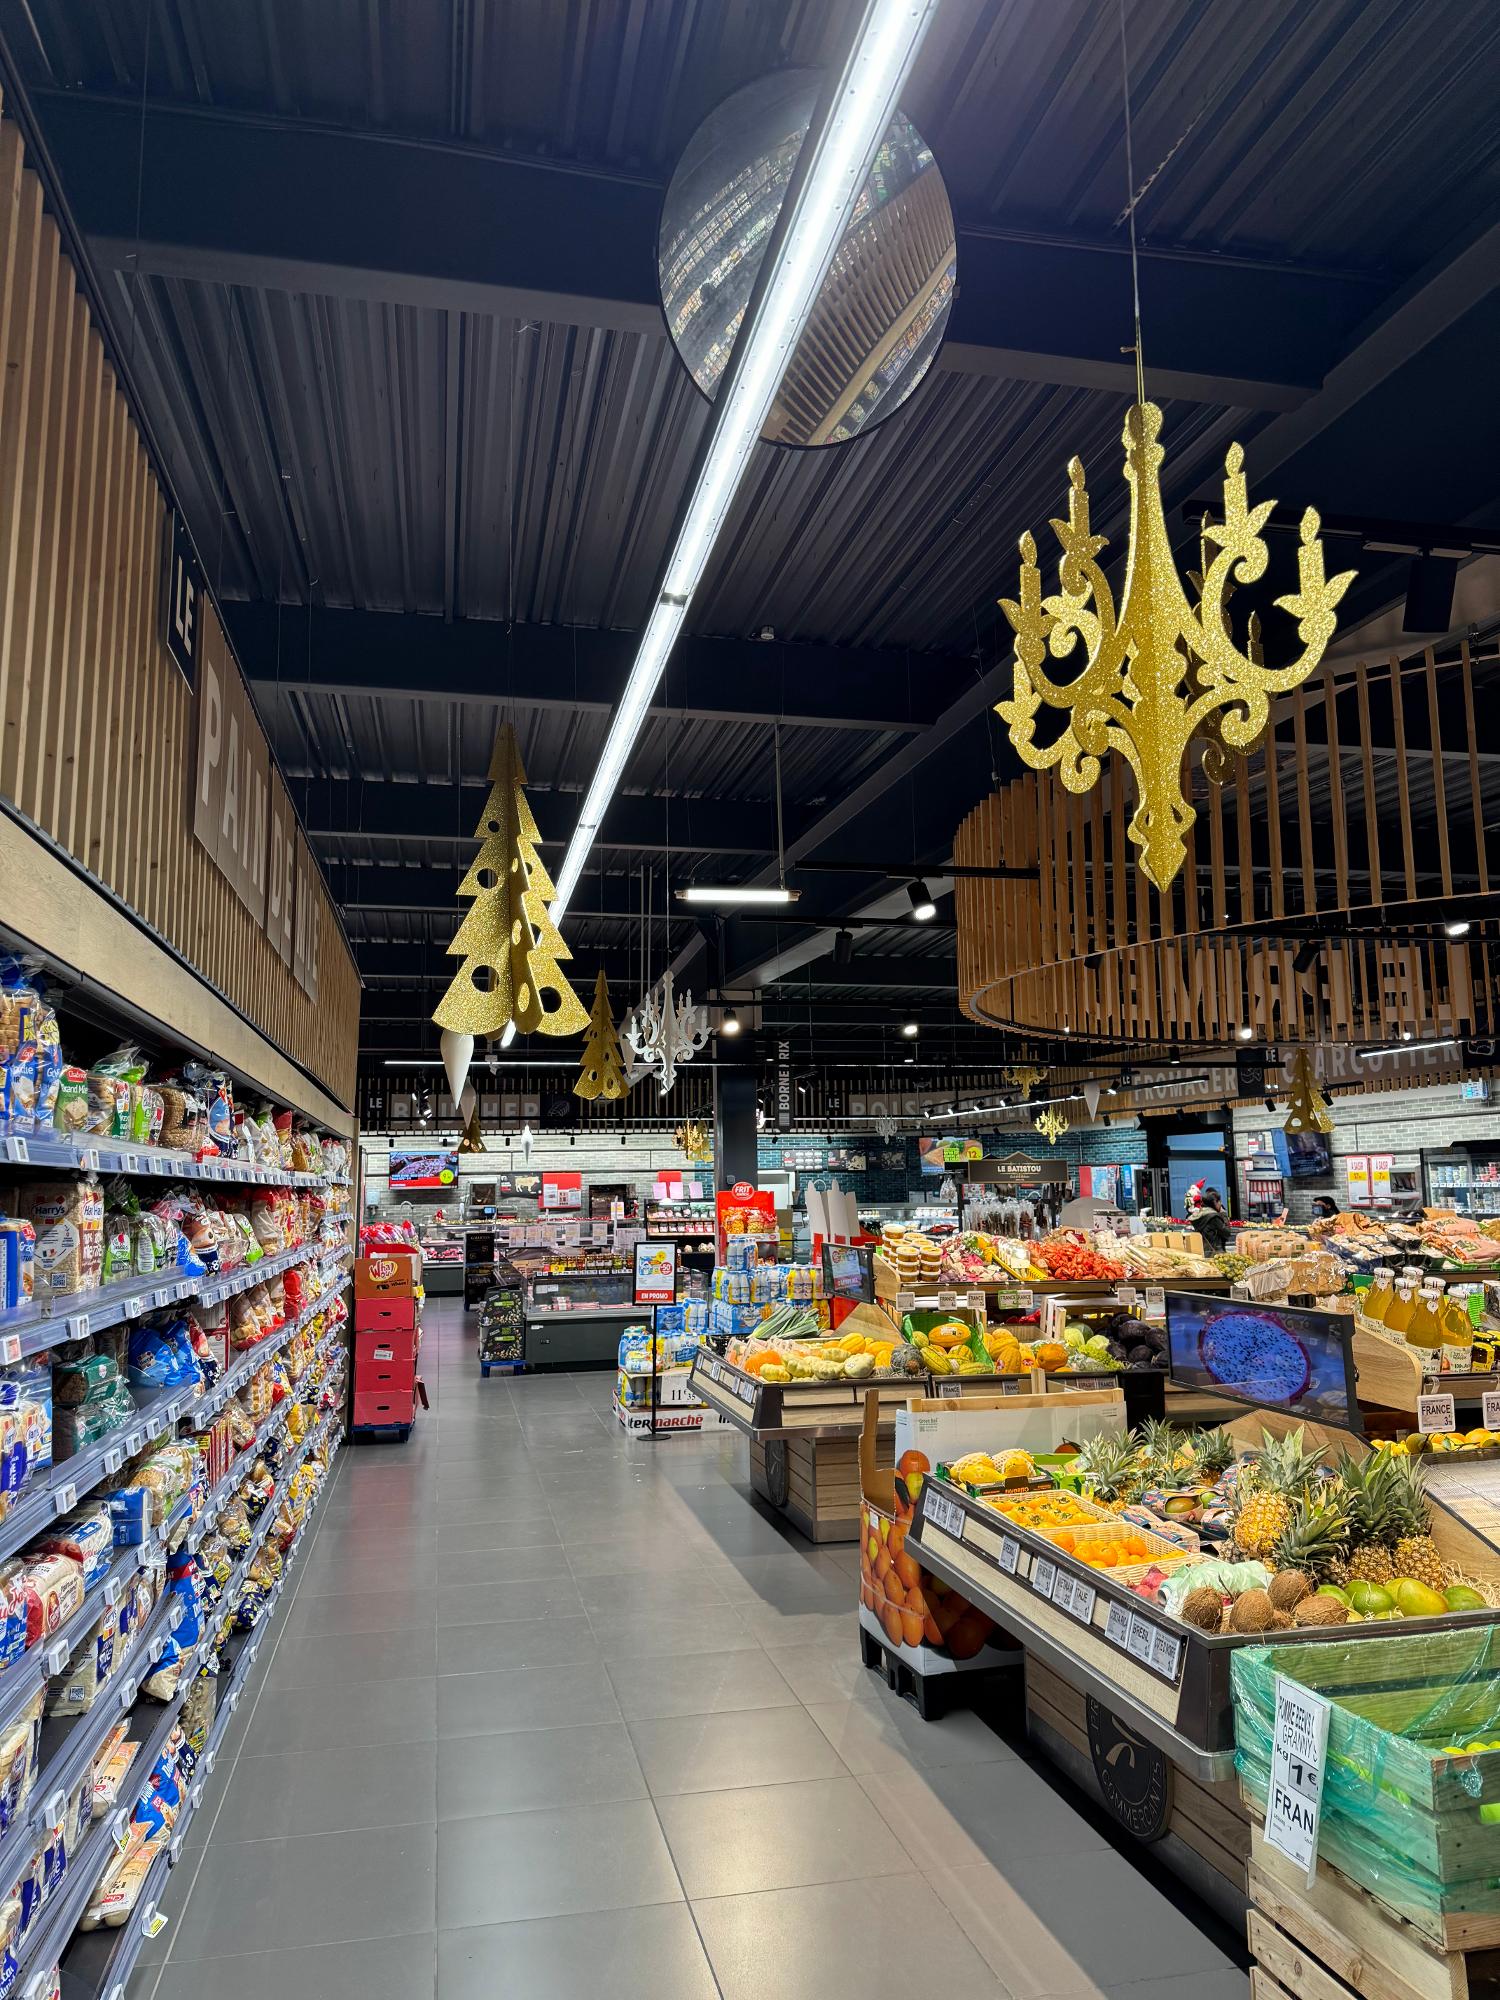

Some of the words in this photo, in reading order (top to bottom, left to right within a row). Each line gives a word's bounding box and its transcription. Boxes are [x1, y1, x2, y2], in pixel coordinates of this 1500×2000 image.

[175, 554, 195, 657] LE
[201, 657, 270, 897] PAIN
[271, 808, 294, 944] DE
[295, 865, 320, 982] MIE
[1282, 1034, 1460, 1084] CARCUTIER
[779, 1070, 790, 1110] BORNE
[369, 1096, 383, 1109] LE
[828, 1097, 840, 1108] LE
[997, 1165, 1006, 1173] LE
[1007, 1165, 1042, 1173] BATISTOU
[735, 1185, 751, 1193] FRIT
[35, 1205, 65, 1215] Harry's
[1421, 1404, 1451, 1416] FRANCE
[1282, 1724, 1312, 1758] GRANNY
[1276, 1743, 1289, 1762] kg
[1291, 1764, 1303, 1786] 1
[1274, 1791, 1314, 1835] FRAN
